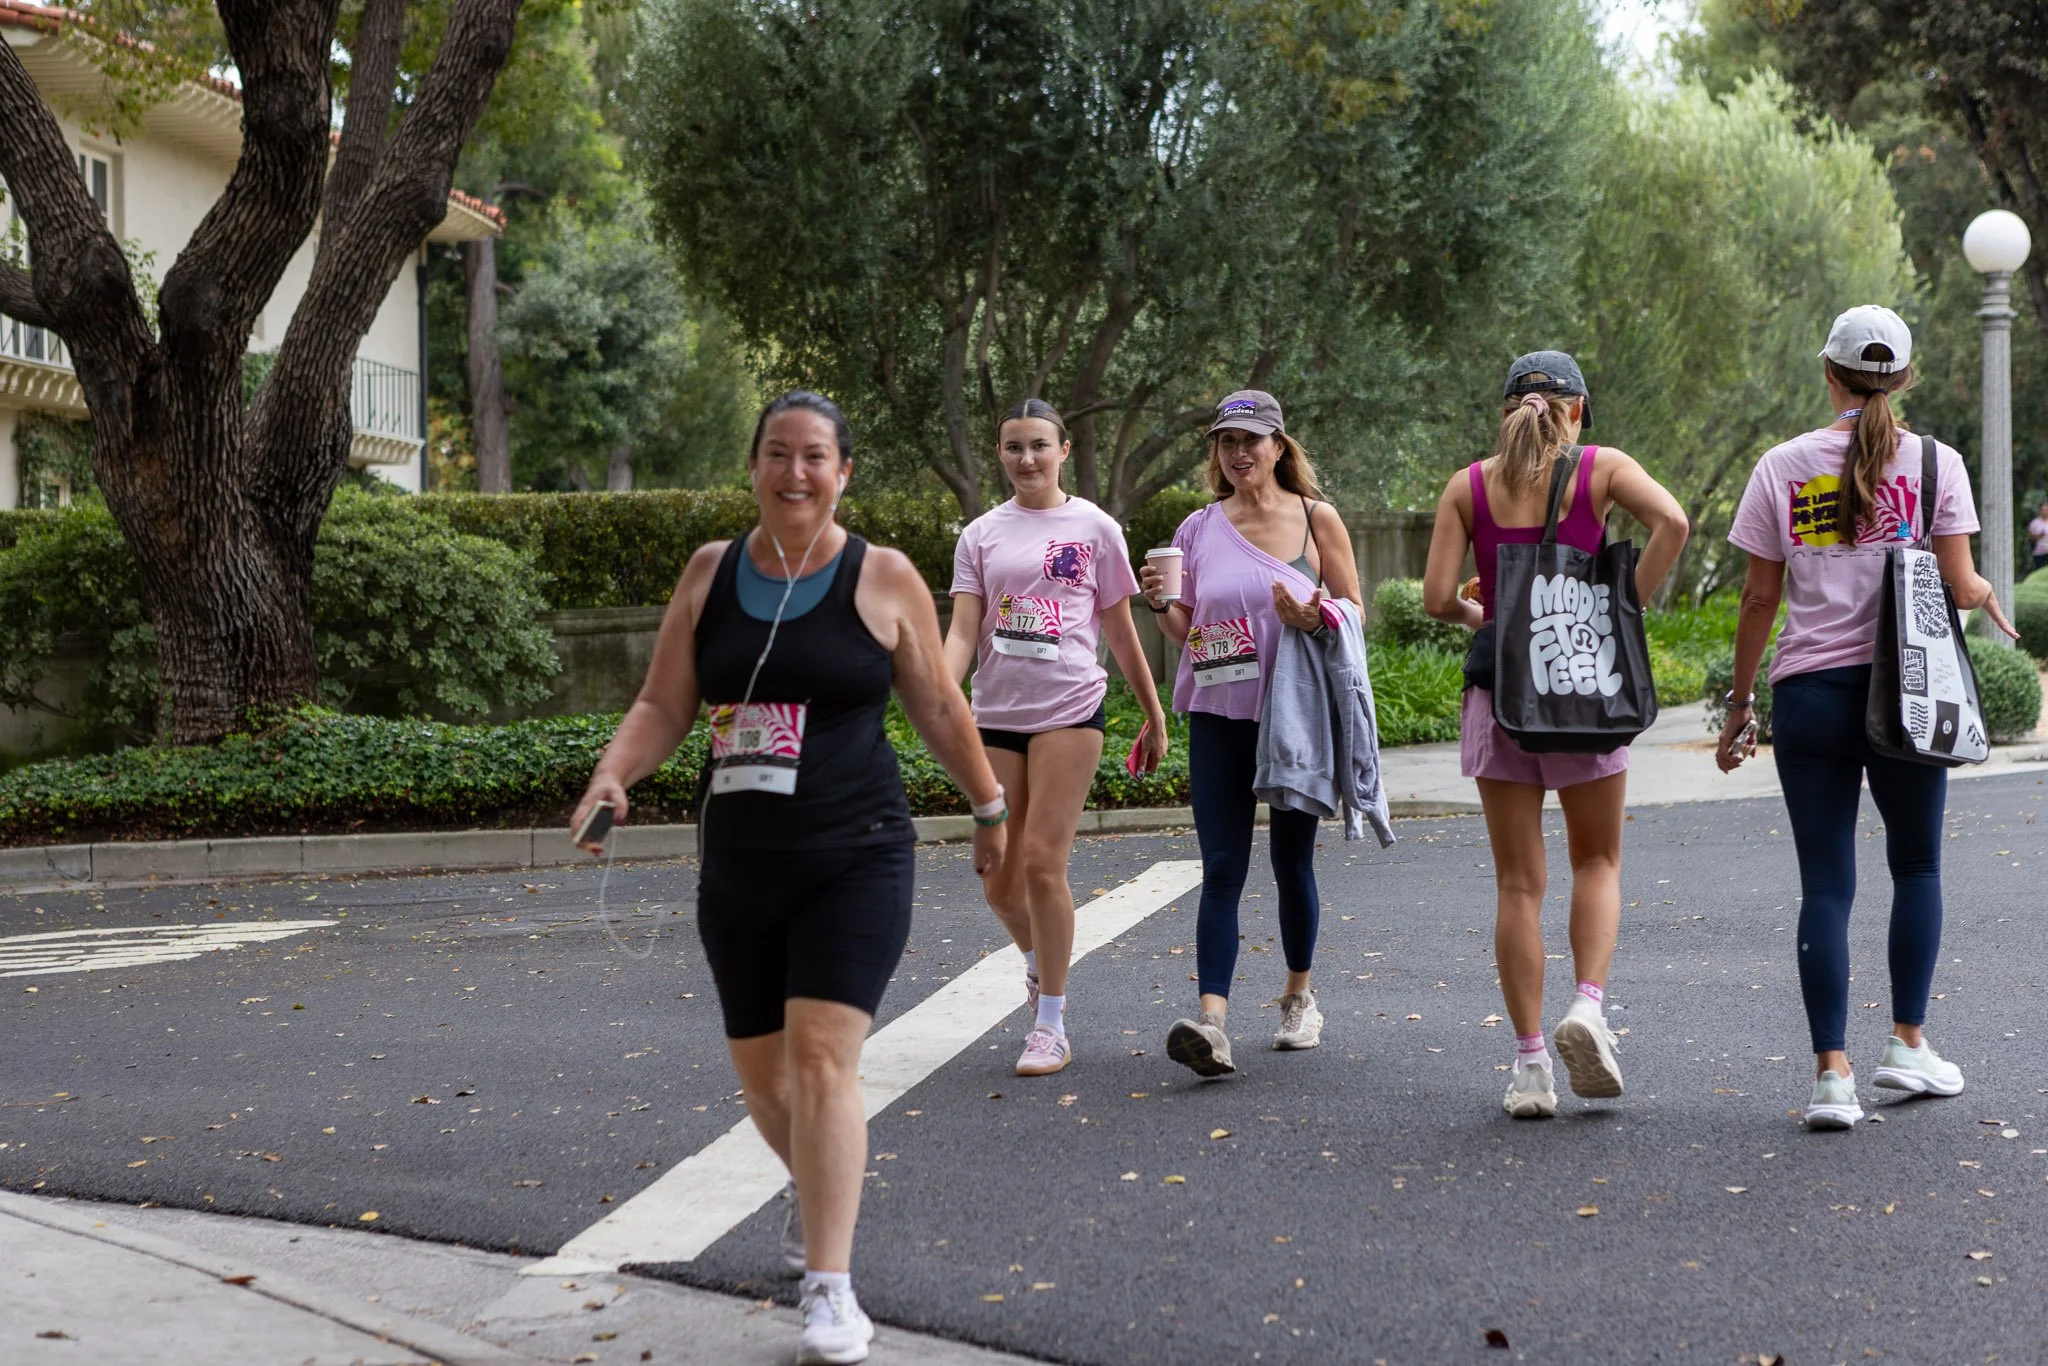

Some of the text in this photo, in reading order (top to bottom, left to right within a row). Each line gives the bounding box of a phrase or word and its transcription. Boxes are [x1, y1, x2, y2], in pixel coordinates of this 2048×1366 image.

[1912, 577, 1933, 590] MORE
[1530, 573, 1613, 636] MADE
[1017, 616, 1035, 629] 177
[1529, 613, 1600, 658] TO
[1211, 641, 1228, 655] 178
[1529, 630, 1623, 697] FEEL
